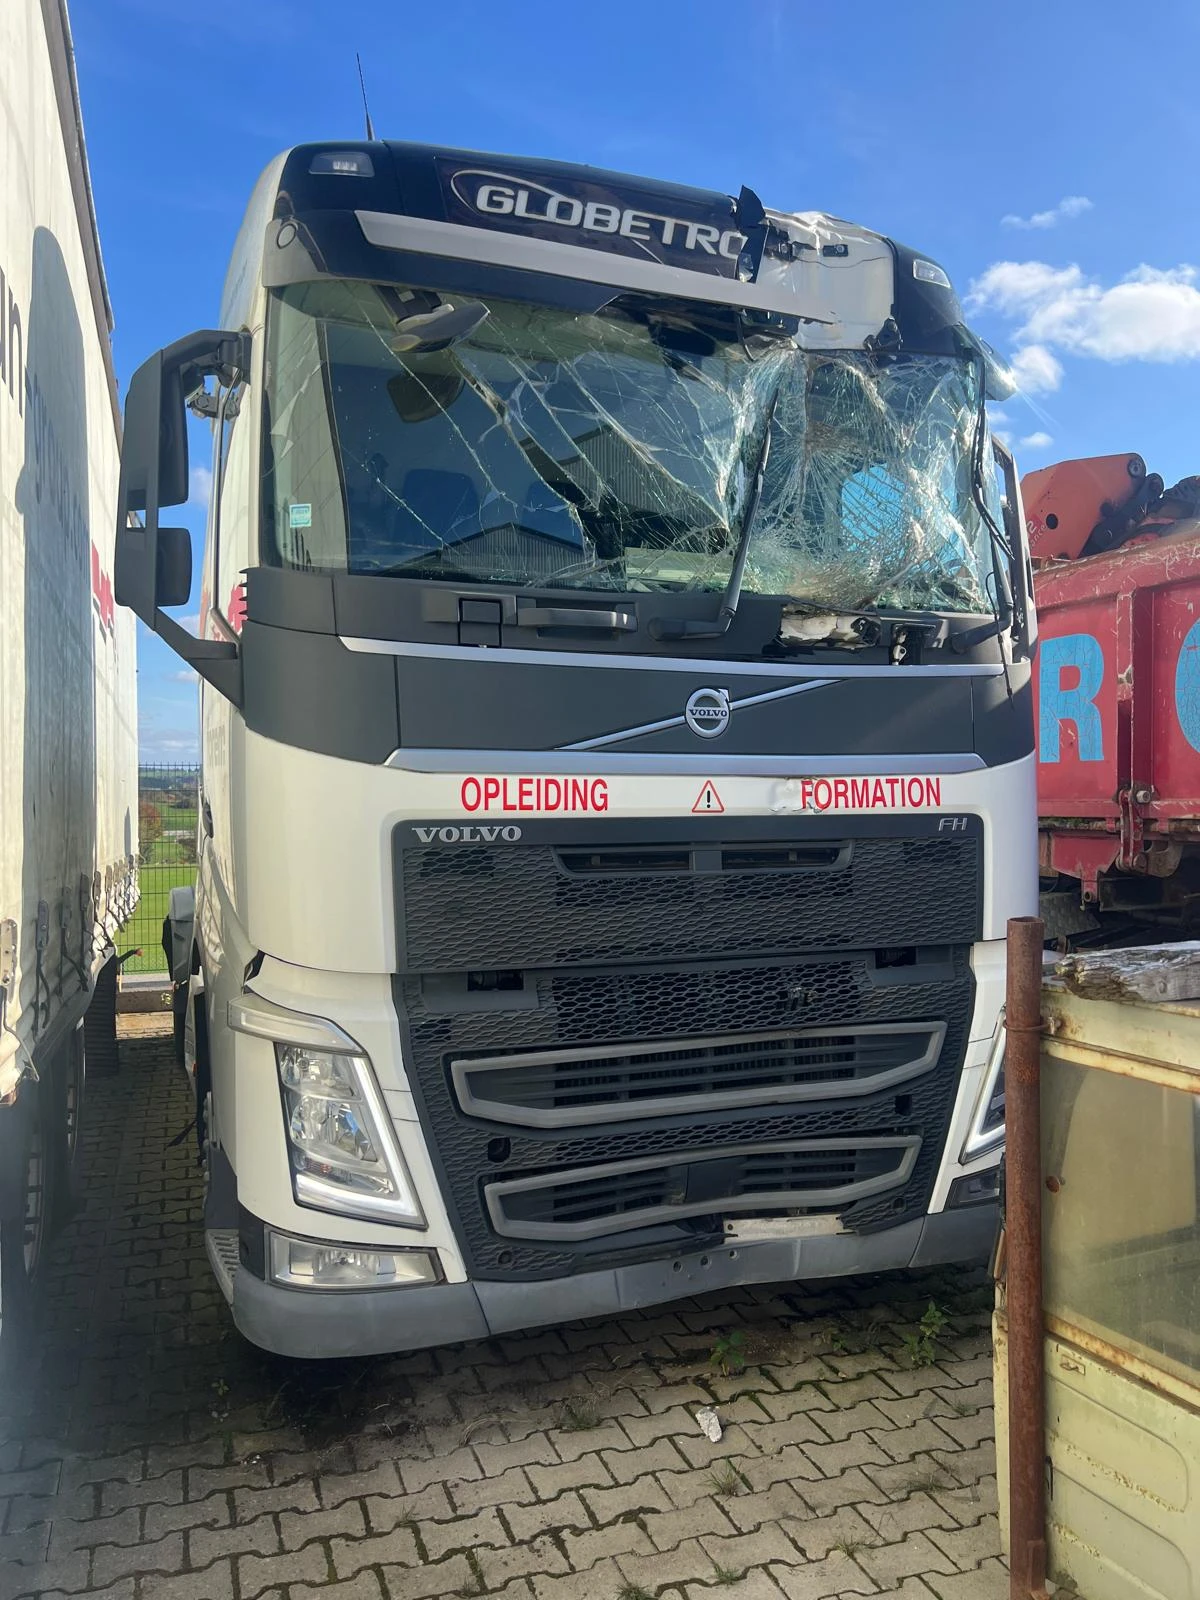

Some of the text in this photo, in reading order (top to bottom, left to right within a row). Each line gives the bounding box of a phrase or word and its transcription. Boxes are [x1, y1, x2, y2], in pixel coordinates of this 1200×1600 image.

[0, 264, 91, 590] n-group.com
[689, 708, 728, 718] VOLVO
[461, 777, 941, 812] OPLEIDING FORMATION
[938, 817, 968, 832] FH
[411, 825, 522, 843] VOLVO
